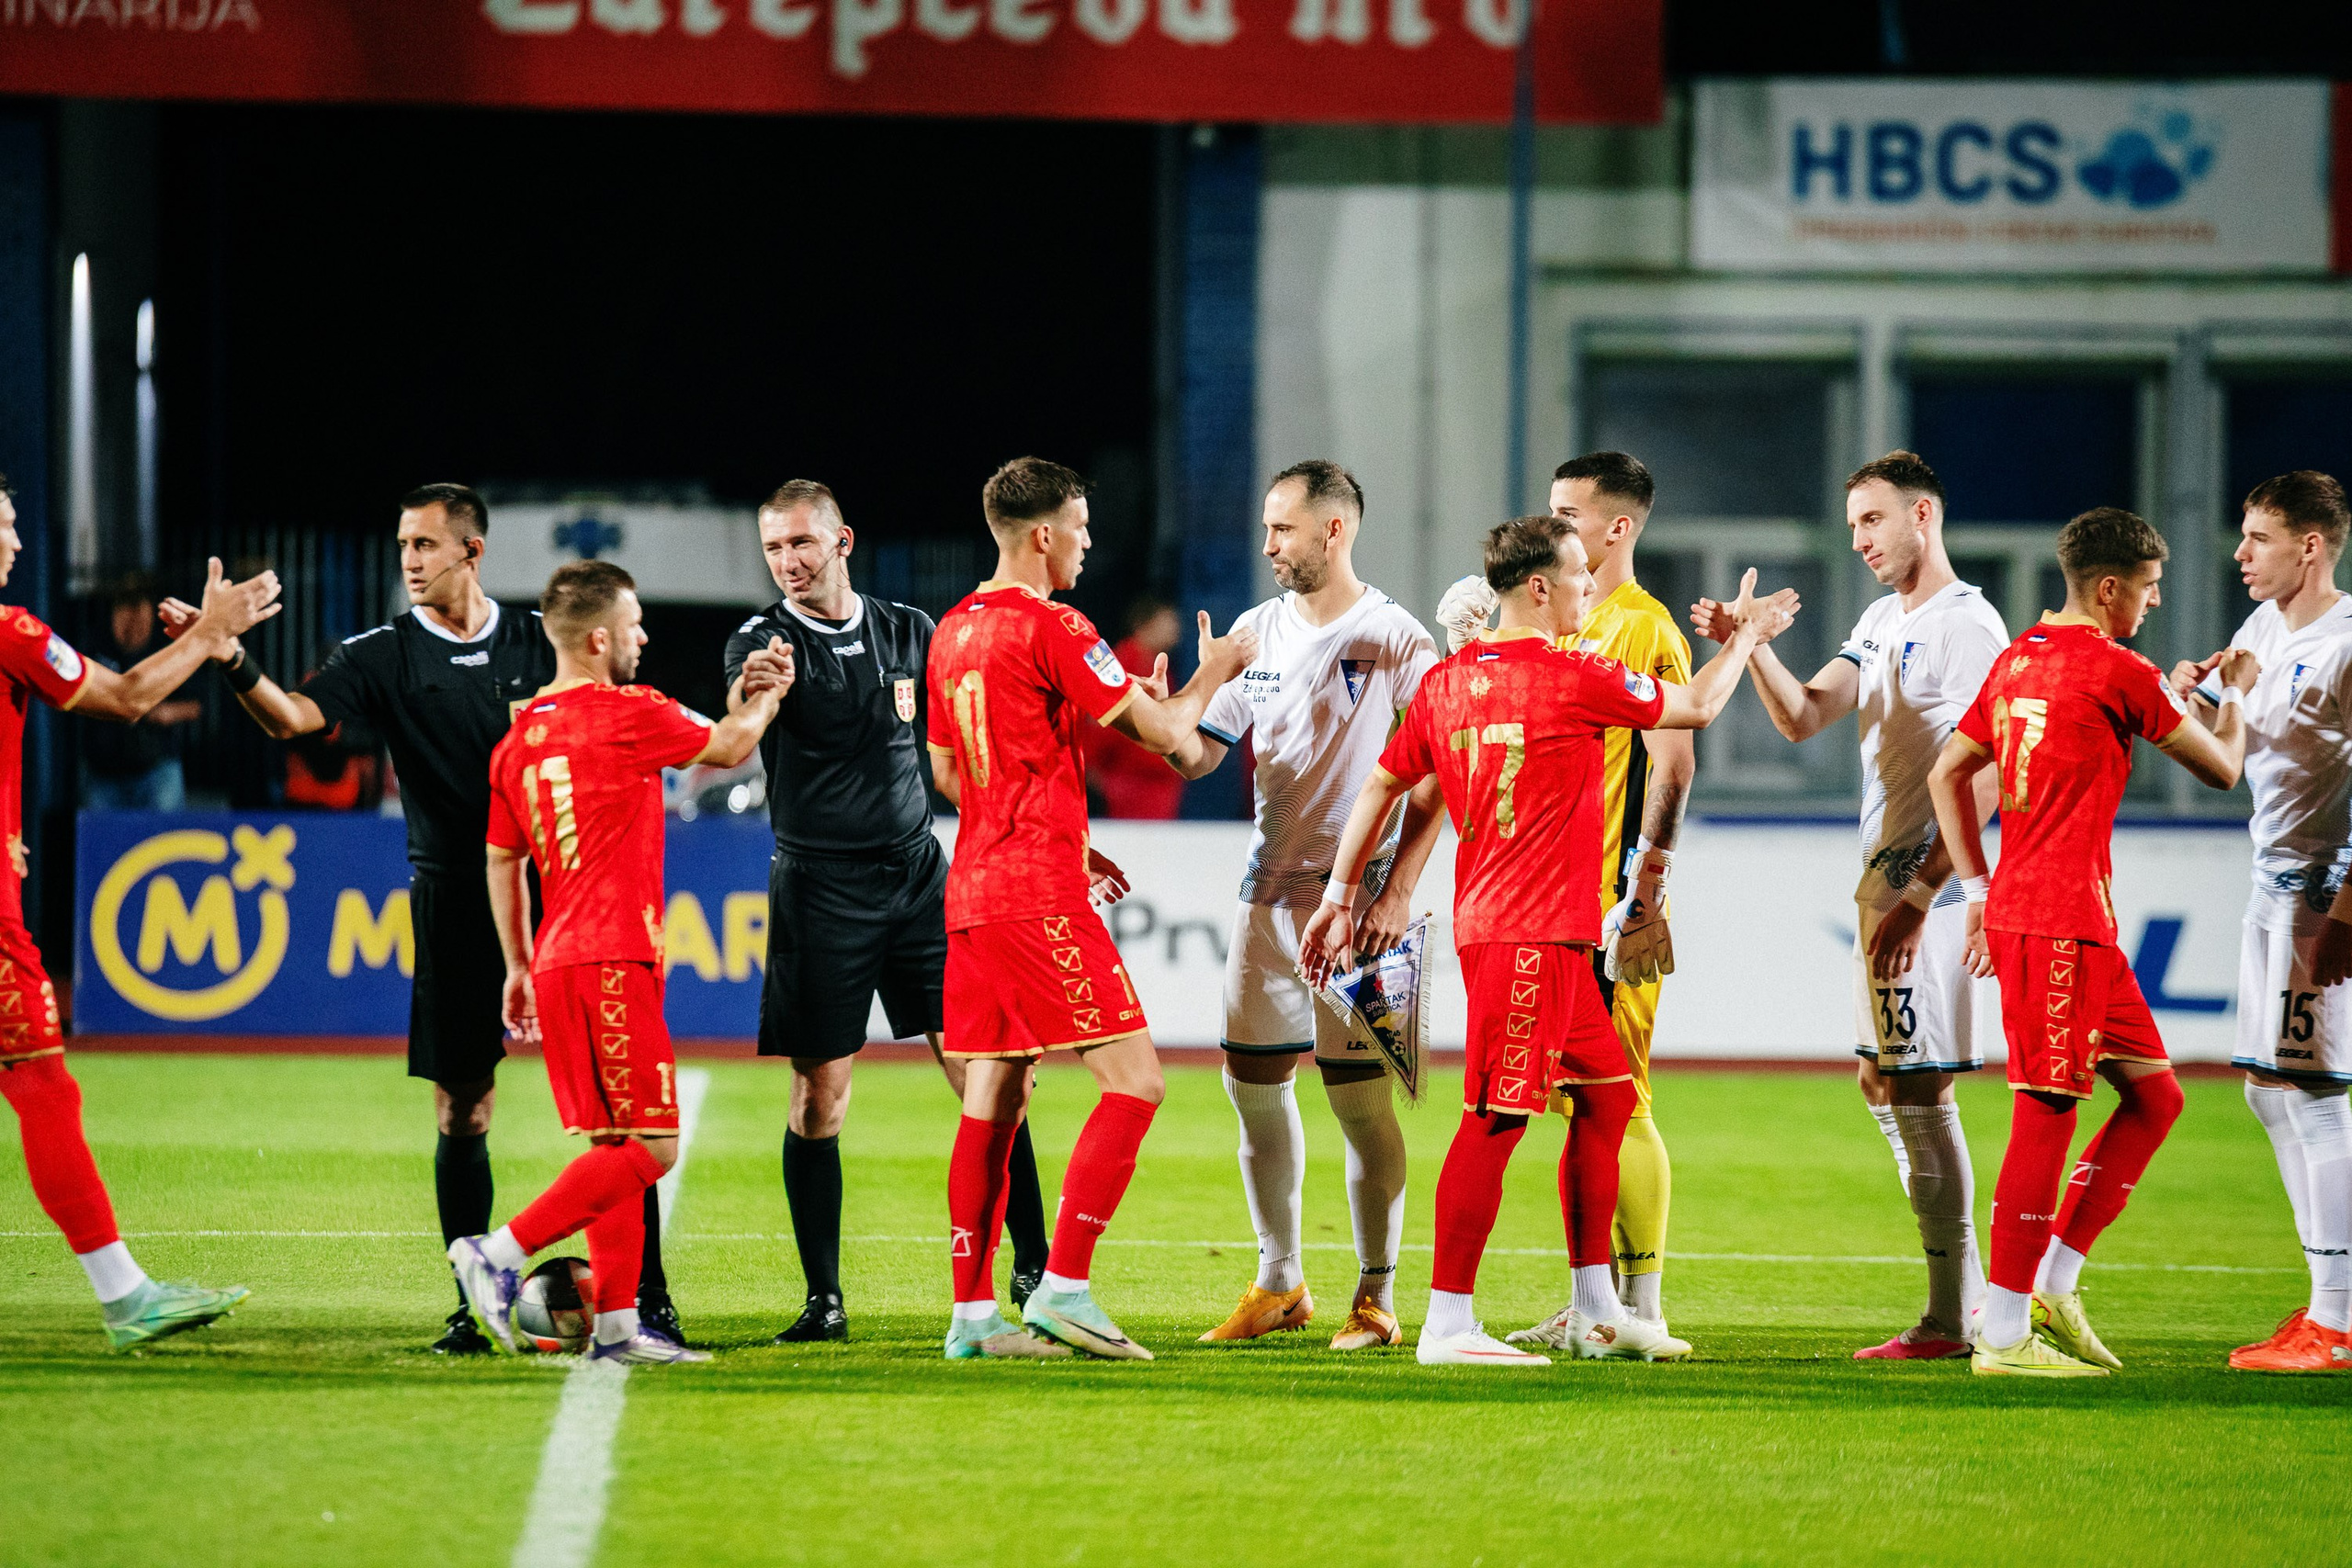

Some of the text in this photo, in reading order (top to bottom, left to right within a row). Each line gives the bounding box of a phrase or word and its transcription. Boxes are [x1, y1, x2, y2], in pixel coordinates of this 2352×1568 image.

[1791, 120, 2063, 206] HBCS
[1243, 670, 1281, 681] LEGEA
[1450, 722, 1525, 843] 77
[521, 755, 582, 877] 11
[1365, 991, 1407, 1012] SPARTAK
[1875, 987, 1917, 1040] 33
[2279, 989, 2319, 1043] 15
